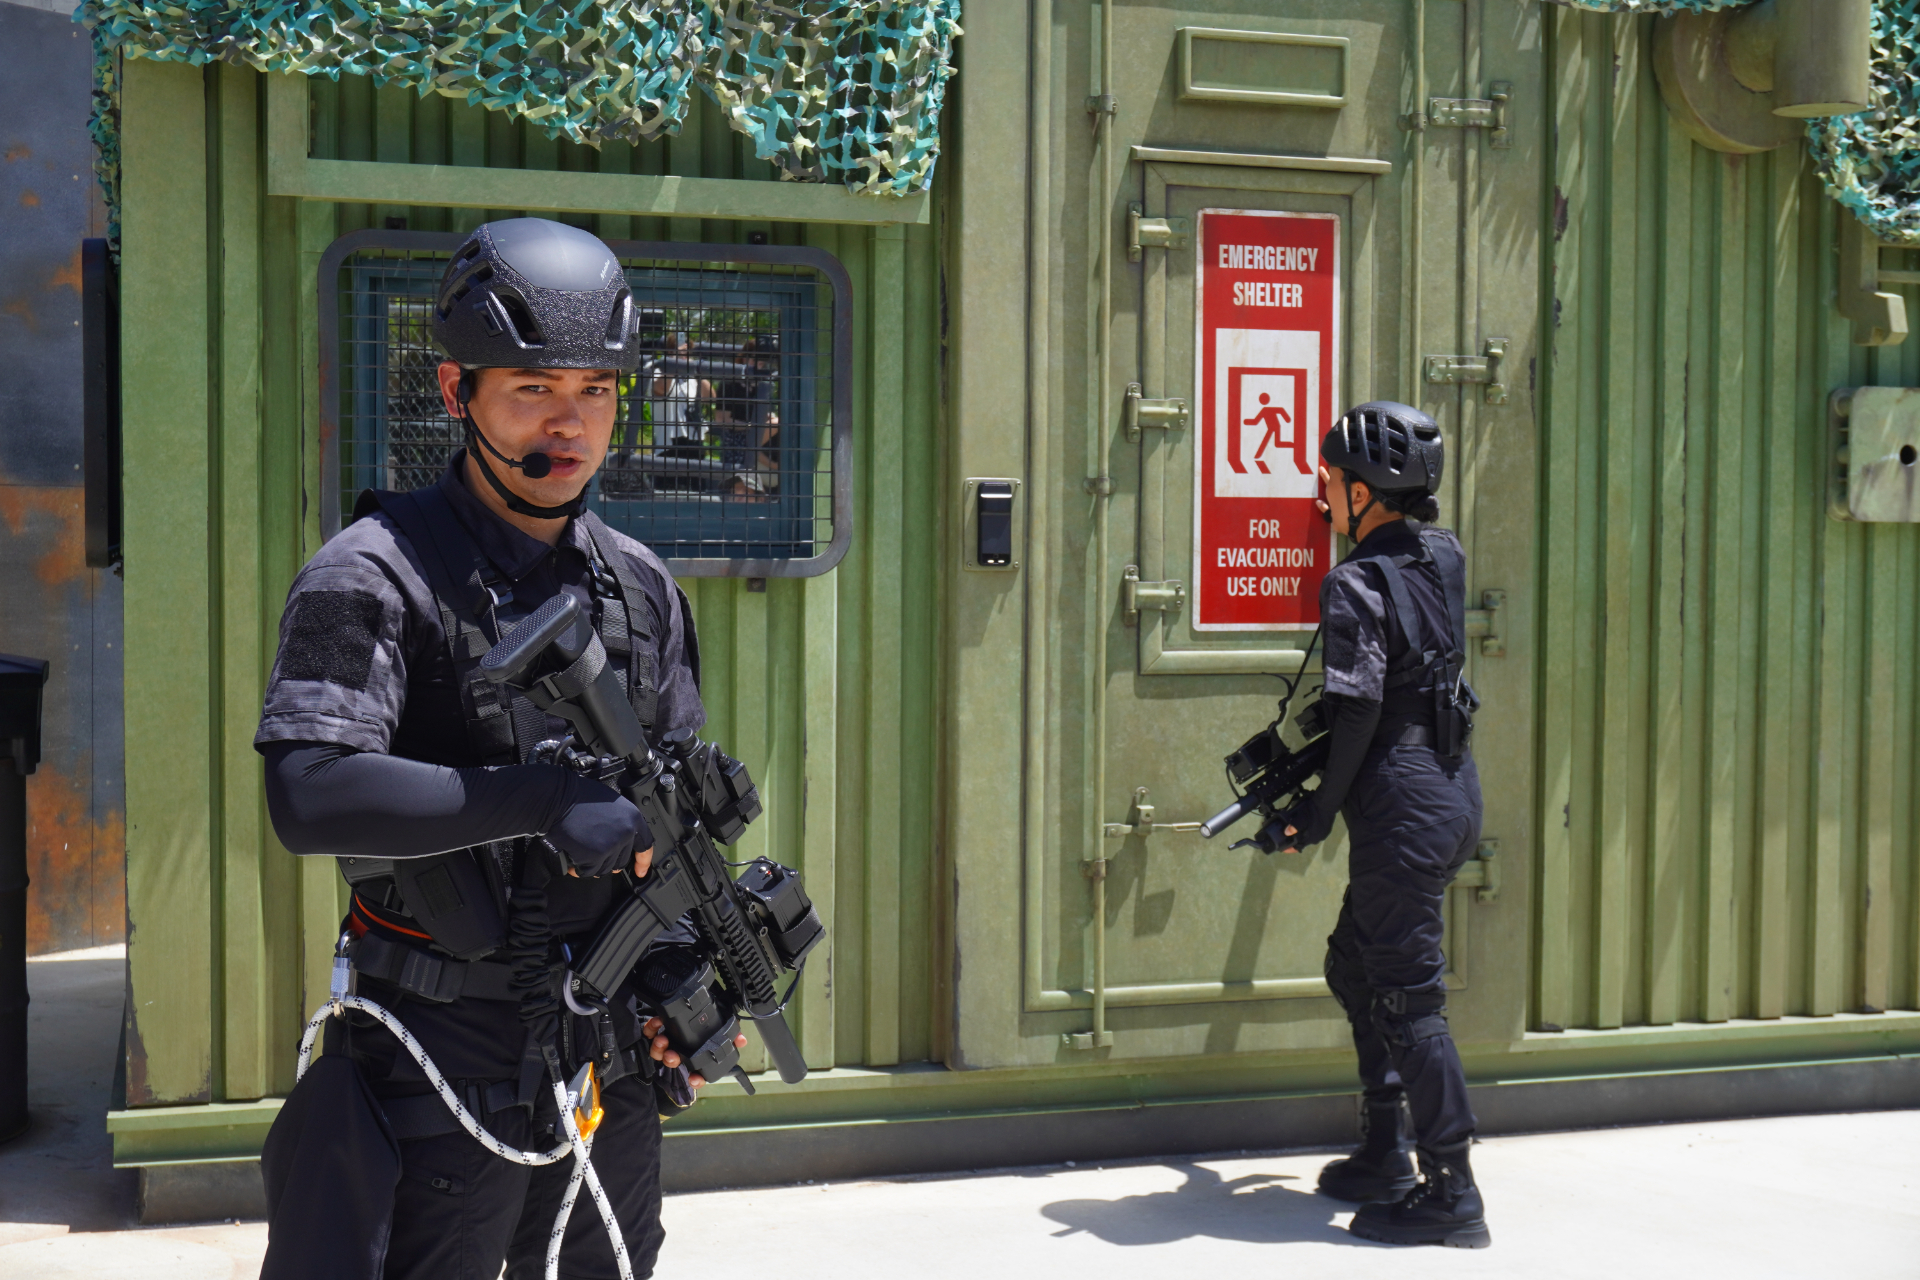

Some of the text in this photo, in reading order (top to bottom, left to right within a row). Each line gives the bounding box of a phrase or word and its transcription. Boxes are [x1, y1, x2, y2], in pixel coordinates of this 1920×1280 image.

[1219, 244, 1318, 271] EMERGENCY
[1233, 281, 1303, 308] SHELTER
[1249, 518, 1280, 539] FOR
[1217, 547, 1314, 568] EVACUATION
[1227, 576, 1301, 596] USE ONLY
